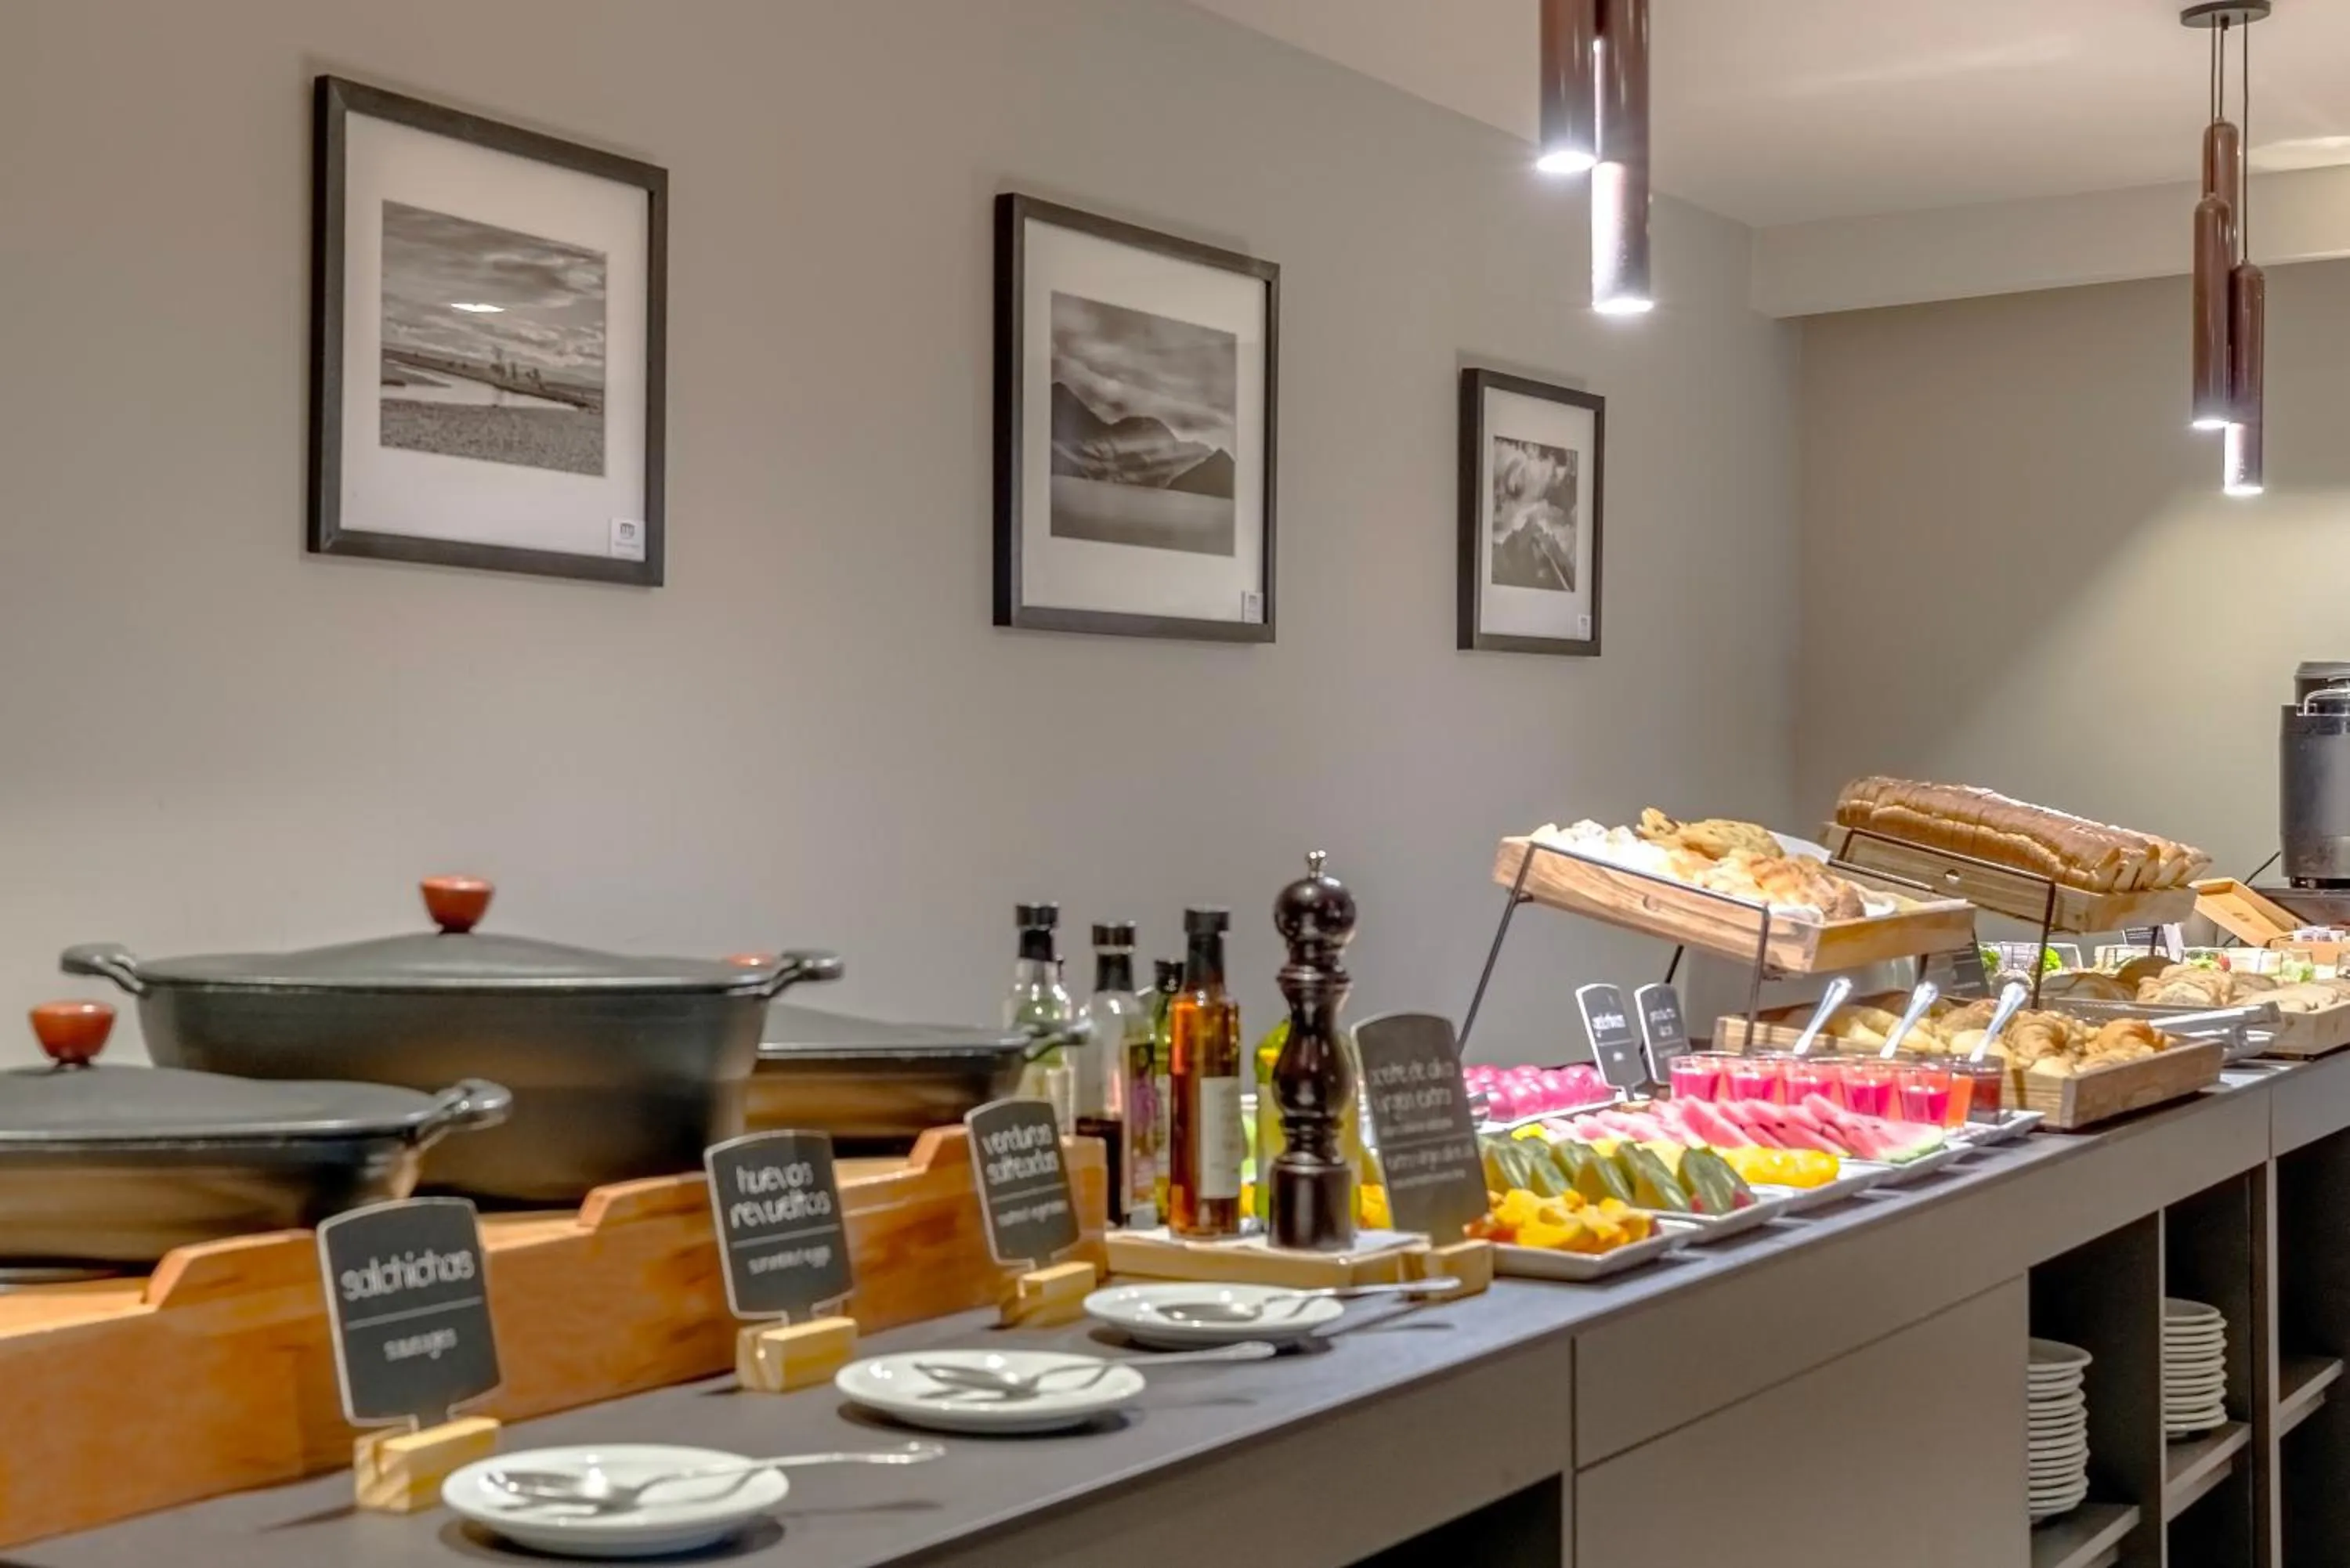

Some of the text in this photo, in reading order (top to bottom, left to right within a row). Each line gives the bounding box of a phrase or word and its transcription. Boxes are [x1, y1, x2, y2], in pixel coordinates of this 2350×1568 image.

[982, 1123, 1053, 1155] verduras
[736, 1162, 814, 1194] huevos
[730, 1189, 831, 1229] revueltos
[340, 1248, 475, 1301] salchichas
